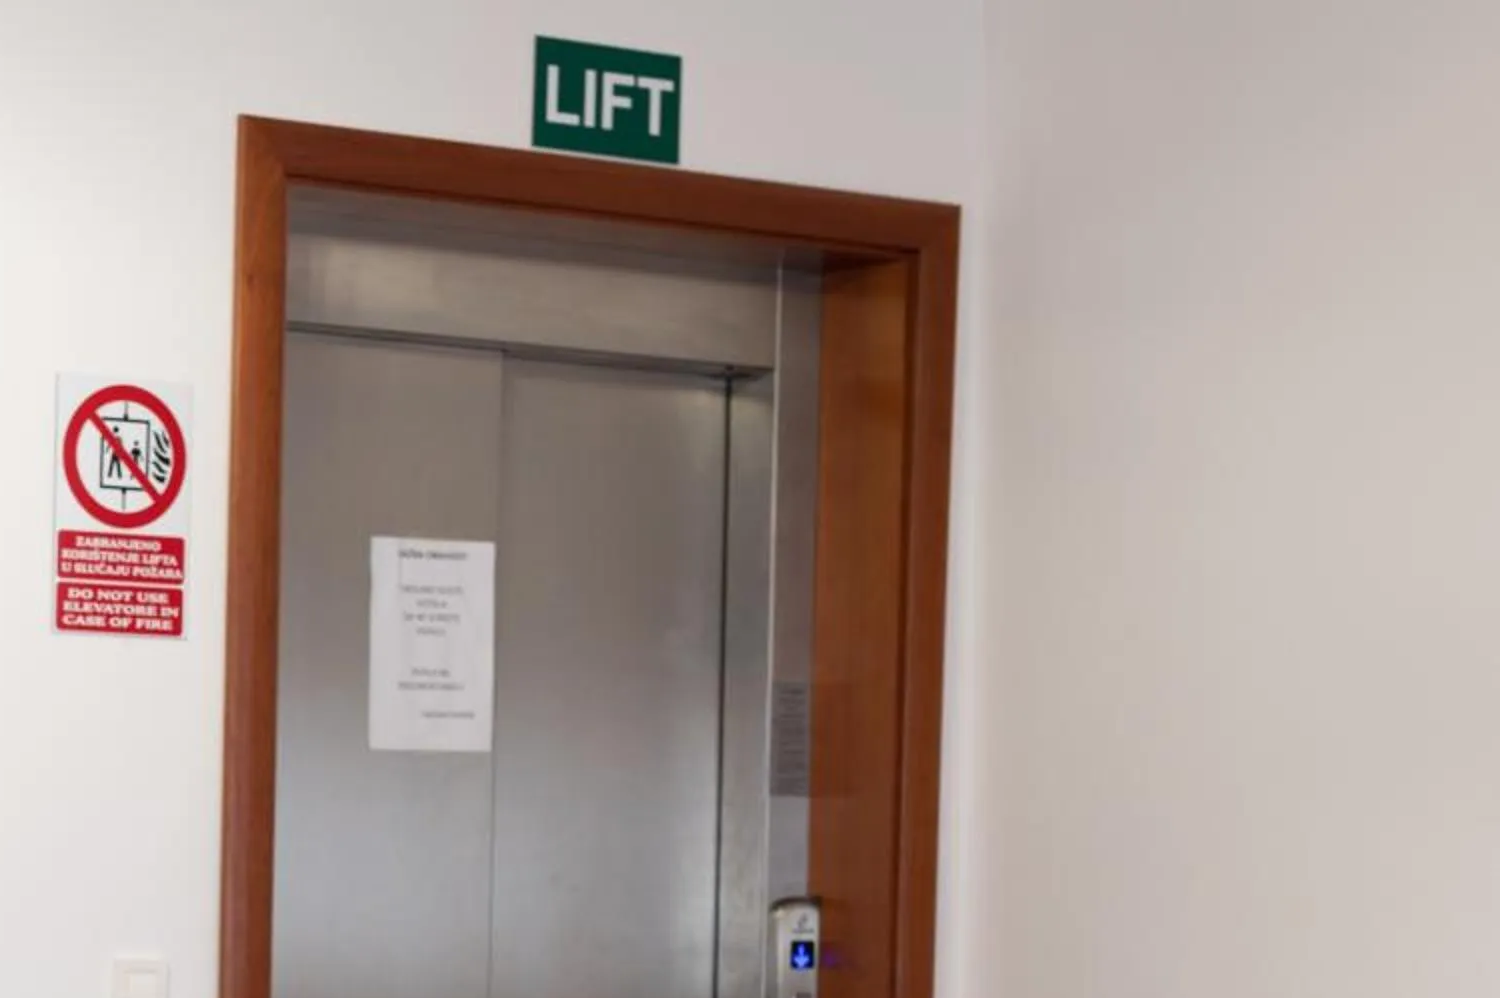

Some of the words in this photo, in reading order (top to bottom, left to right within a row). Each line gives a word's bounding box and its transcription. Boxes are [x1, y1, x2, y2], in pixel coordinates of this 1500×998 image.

[545, 64, 675, 137] LIFT
[75, 535, 162, 552] ZABRANJENO
[61, 561, 72, 573] U
[142, 553, 179, 567] LIFTA
[67, 587, 94, 600] DO
[97, 589, 133, 602] NOT
[136, 591, 170, 604] USE
[62, 600, 158, 616] ELEVATORE
[160, 606, 180, 618] IN
[62, 613, 106, 627] CASE
[109, 617, 133, 629] OF
[135, 618, 173, 631] FIRE
